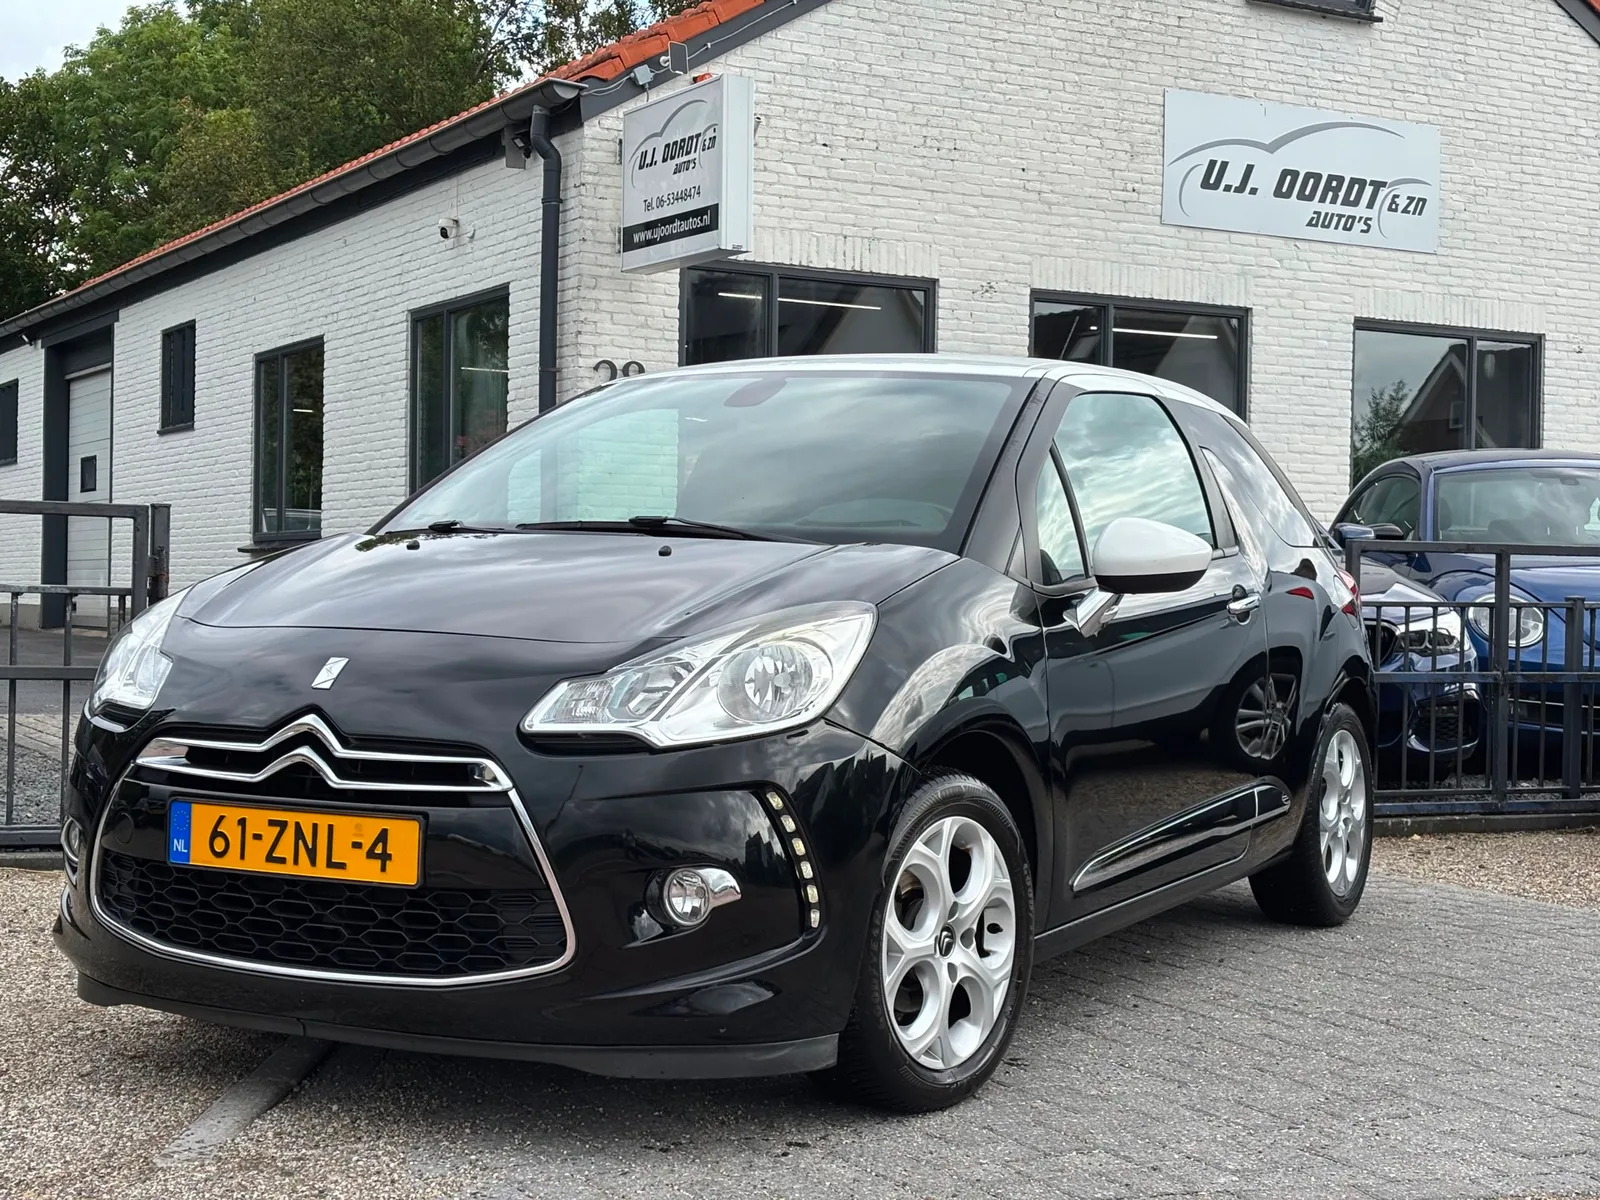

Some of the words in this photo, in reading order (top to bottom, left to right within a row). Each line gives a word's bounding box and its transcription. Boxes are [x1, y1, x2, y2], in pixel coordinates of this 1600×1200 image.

[638, 147, 657, 170] U.J.
[662, 132, 701, 163] OORDT
[643, 197, 654, 212] Tel.
[655, 185, 700, 208] 06-53448474
[1200, 159, 1259, 196] U.J.
[1272, 168, 1388, 210] OORDT
[1386, 193, 1400, 213] &
[633, 210, 710, 243] www.ujoordtautos.nl
[1305, 210, 1373, 235] AUTO'S
[173, 838, 188, 853] NL
[207, 814, 393, 873] 61-ZNL-4
